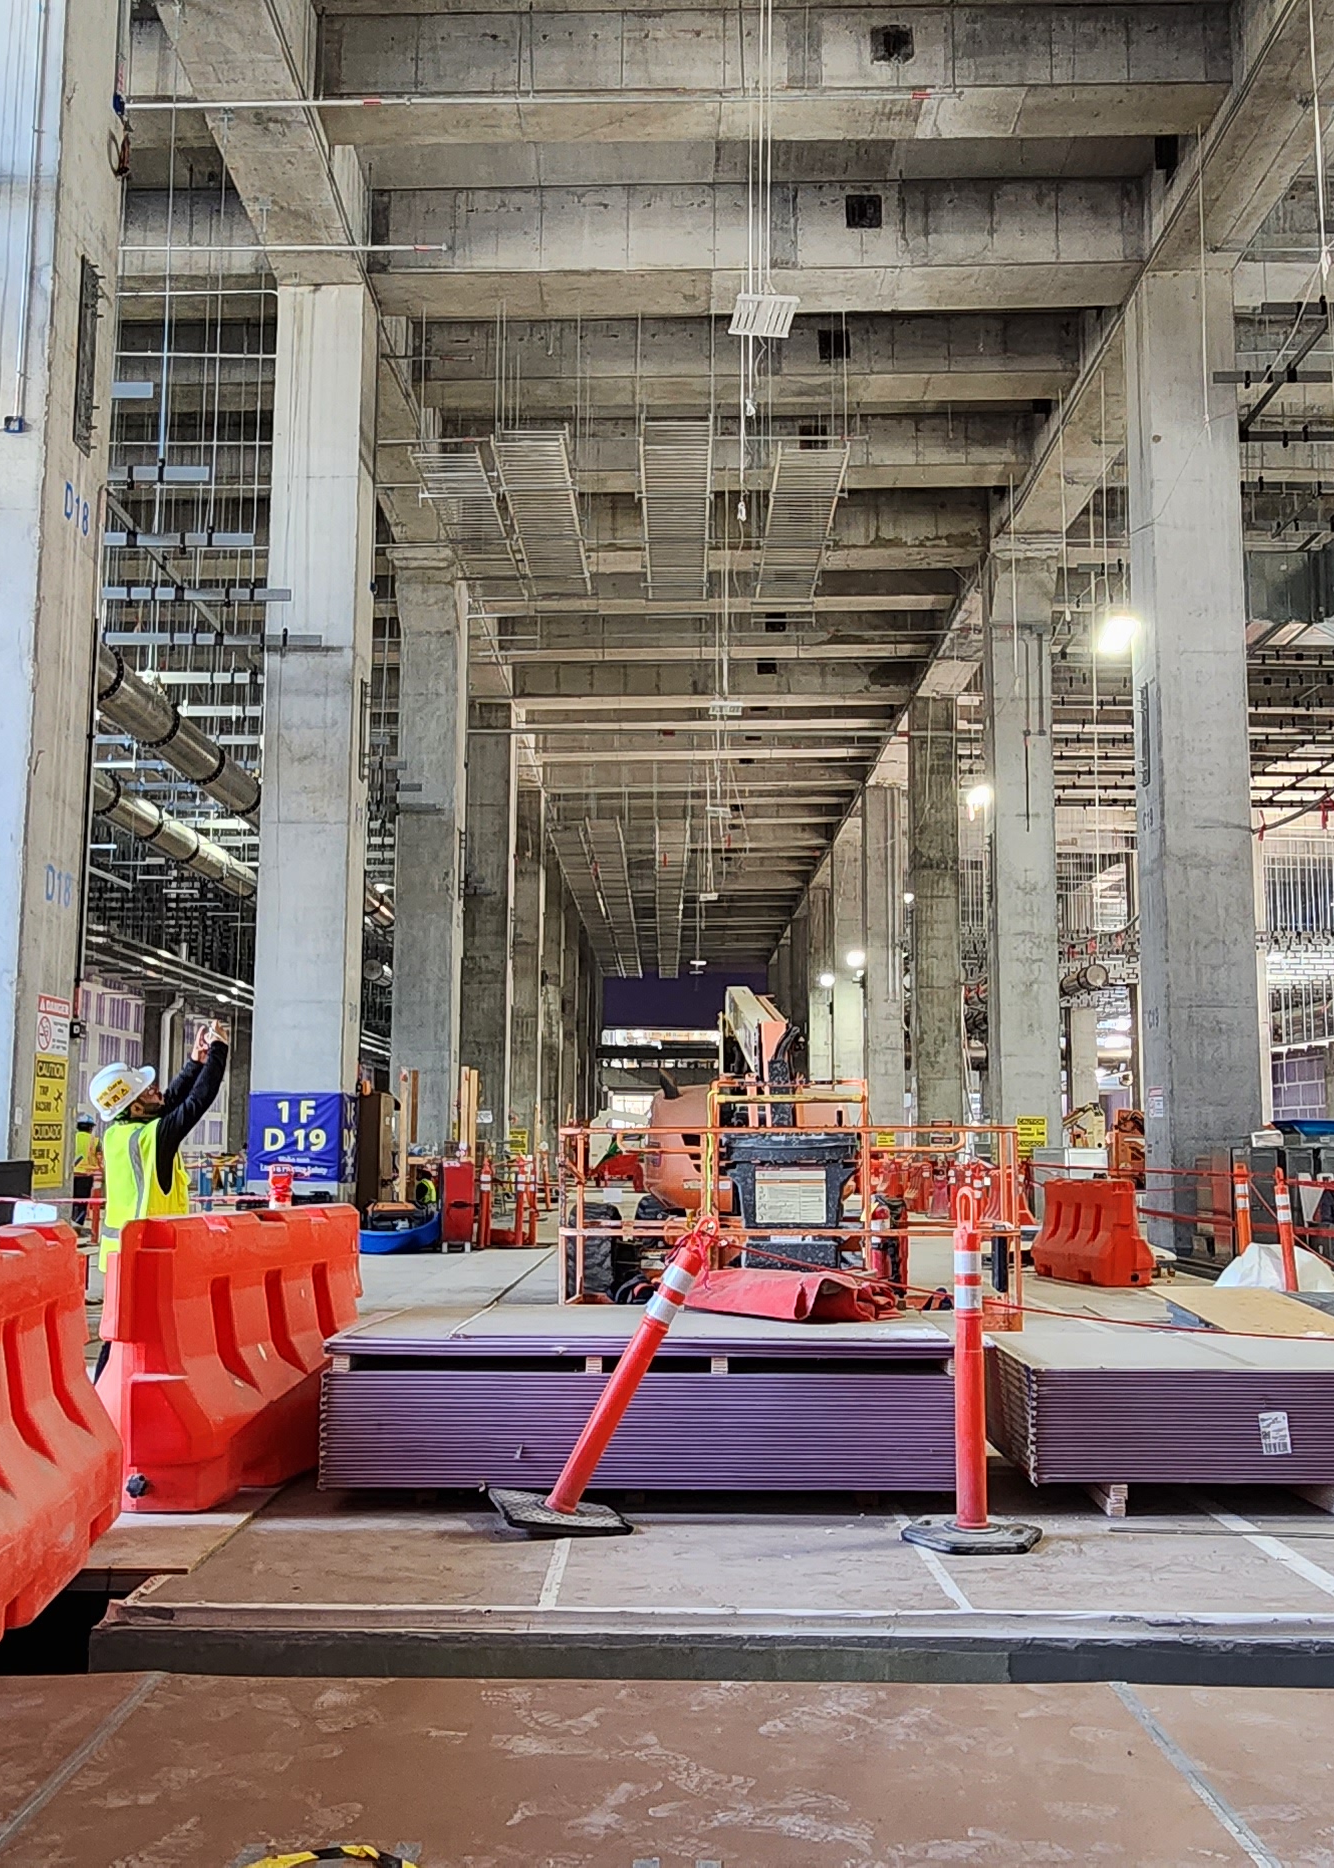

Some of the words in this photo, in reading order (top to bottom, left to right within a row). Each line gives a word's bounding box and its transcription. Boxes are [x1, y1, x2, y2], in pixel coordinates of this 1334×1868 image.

[64, 482, 90, 536] D18
[45, 864, 72, 908] D18
[277, 1101, 289, 1123] 1
[300, 1100, 316, 1123] F
[263, 1128, 285, 1151] D
[294, 1128, 327, 1151] 19
